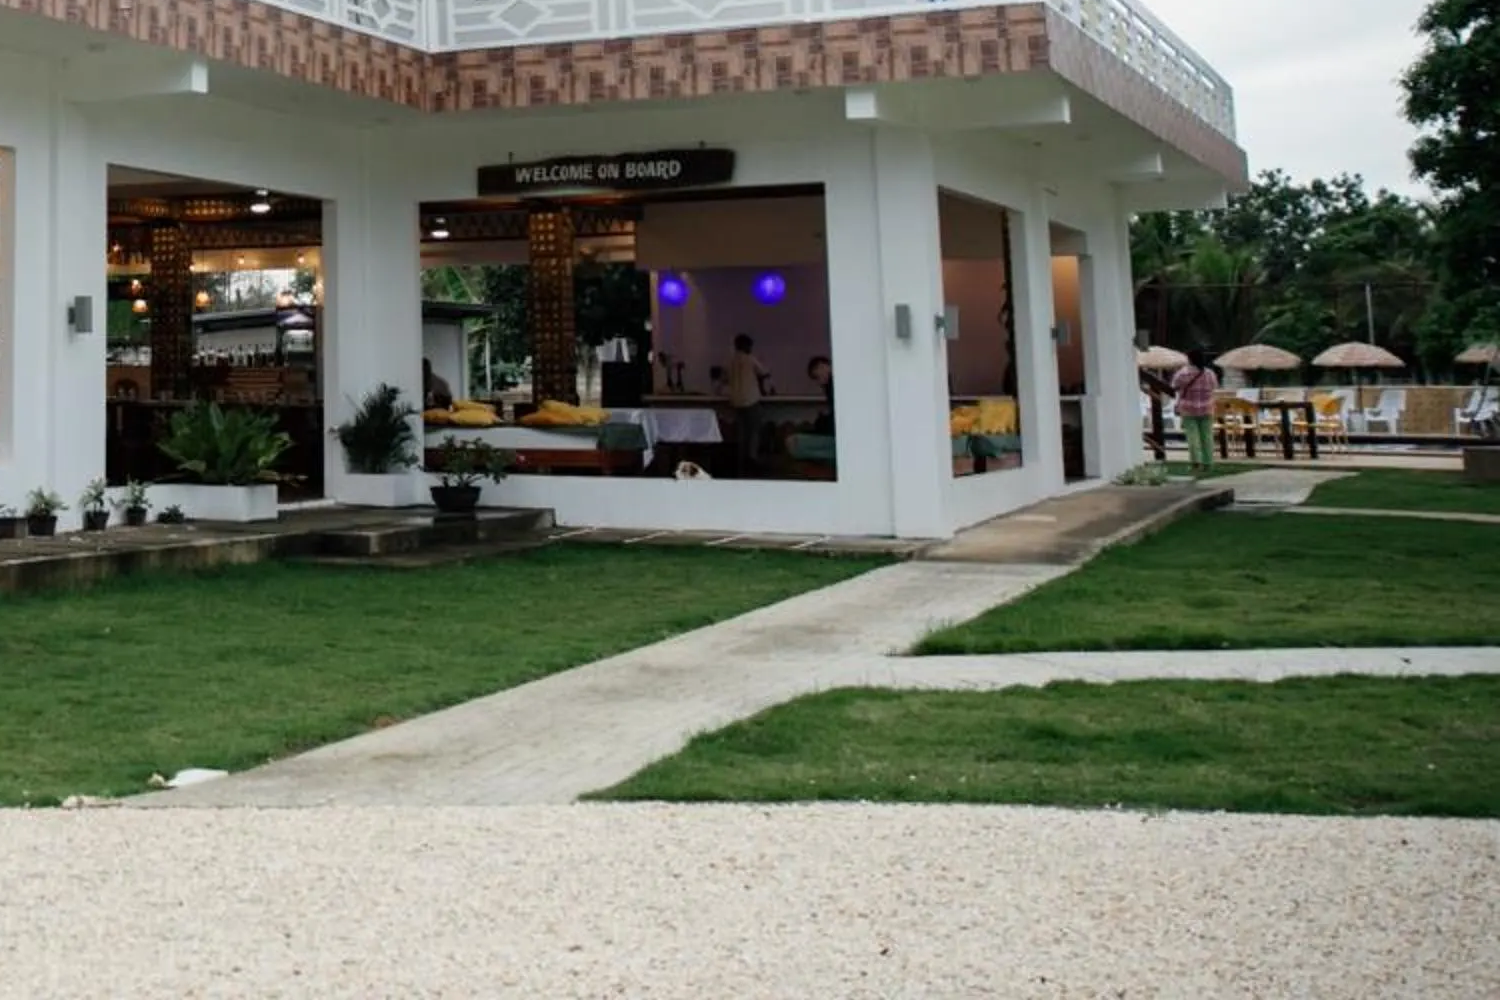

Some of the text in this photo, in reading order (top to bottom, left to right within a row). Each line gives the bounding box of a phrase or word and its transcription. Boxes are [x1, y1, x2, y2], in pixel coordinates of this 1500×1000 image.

[516, 160, 681, 183] WELCOME ON BOARD
